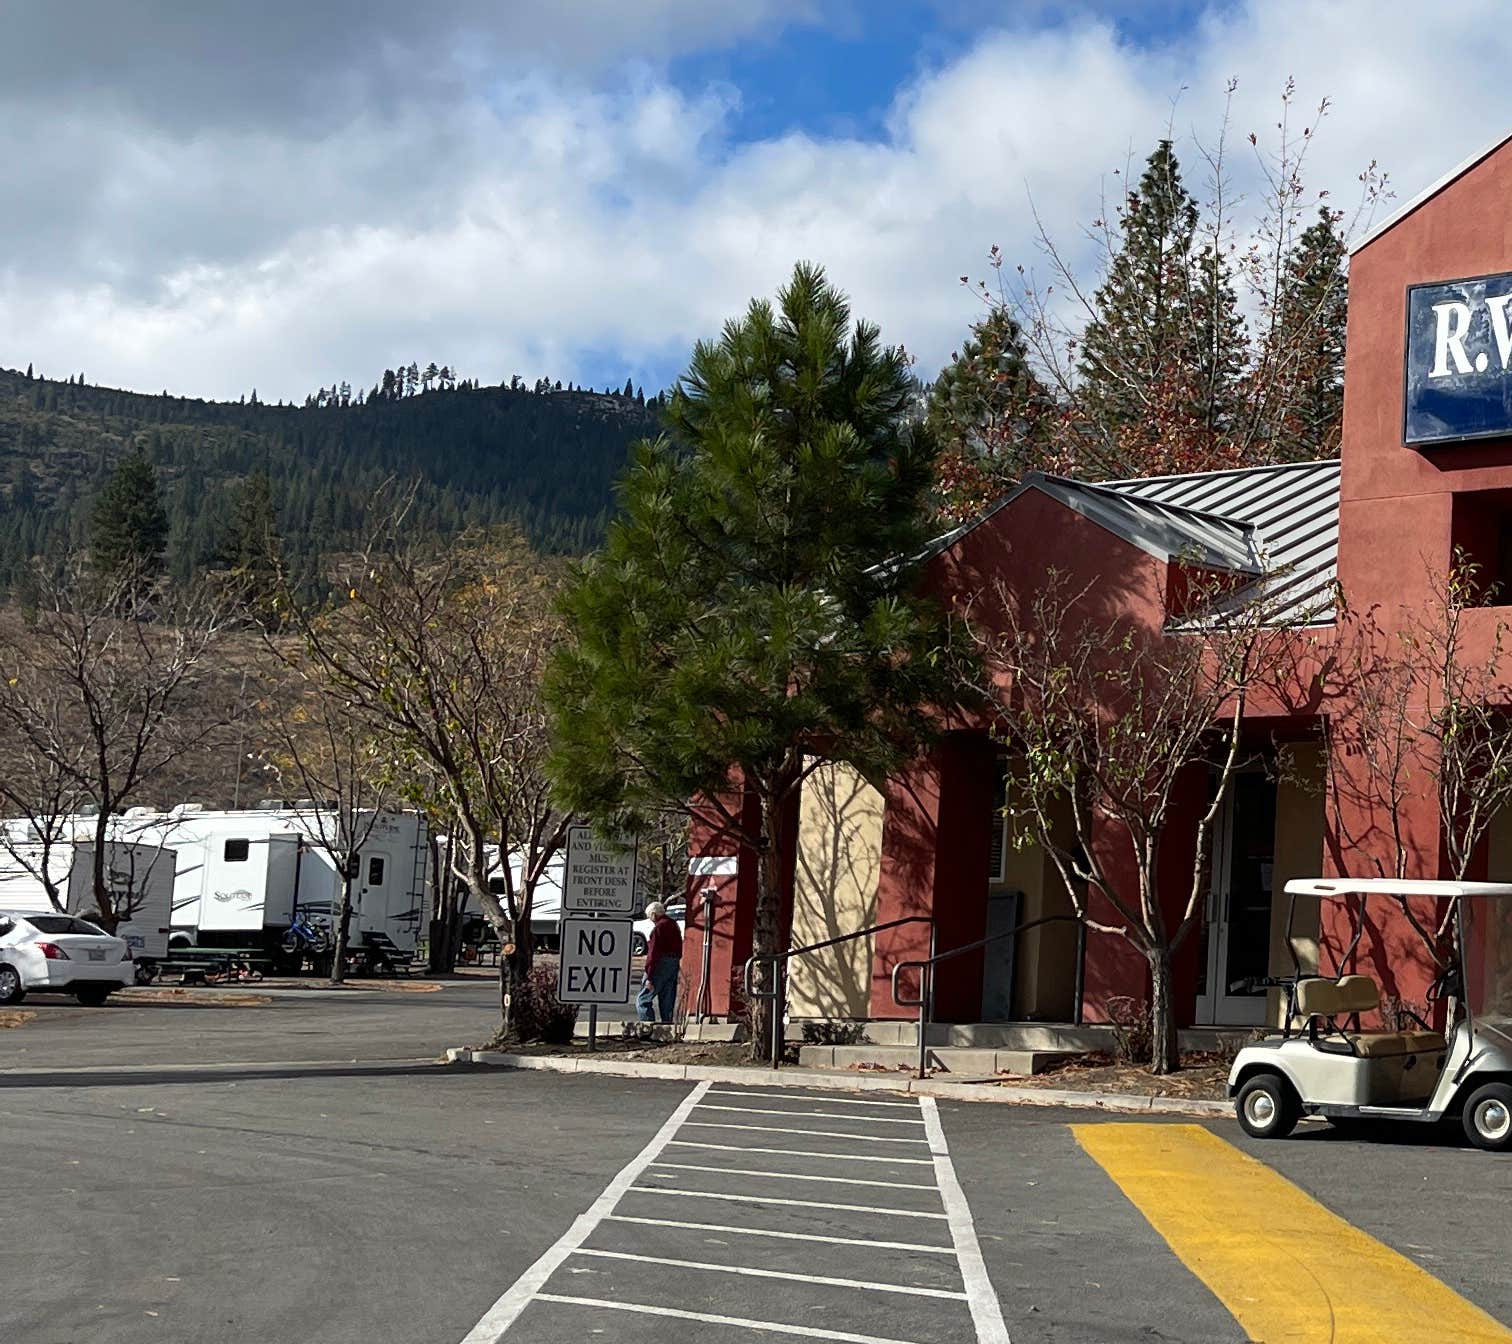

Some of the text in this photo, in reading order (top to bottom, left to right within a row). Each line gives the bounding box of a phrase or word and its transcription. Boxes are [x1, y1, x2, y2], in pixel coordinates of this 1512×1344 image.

[572, 841, 591, 851] AND
[573, 864, 630, 875] REGISTER AT
[573, 875, 628, 886] FRONT DESK
[583, 887, 617, 897] BEFORE
[576, 897, 622, 908] ENTERING
[577, 929, 616, 957] NO
[567, 966, 623, 994] EXIT
